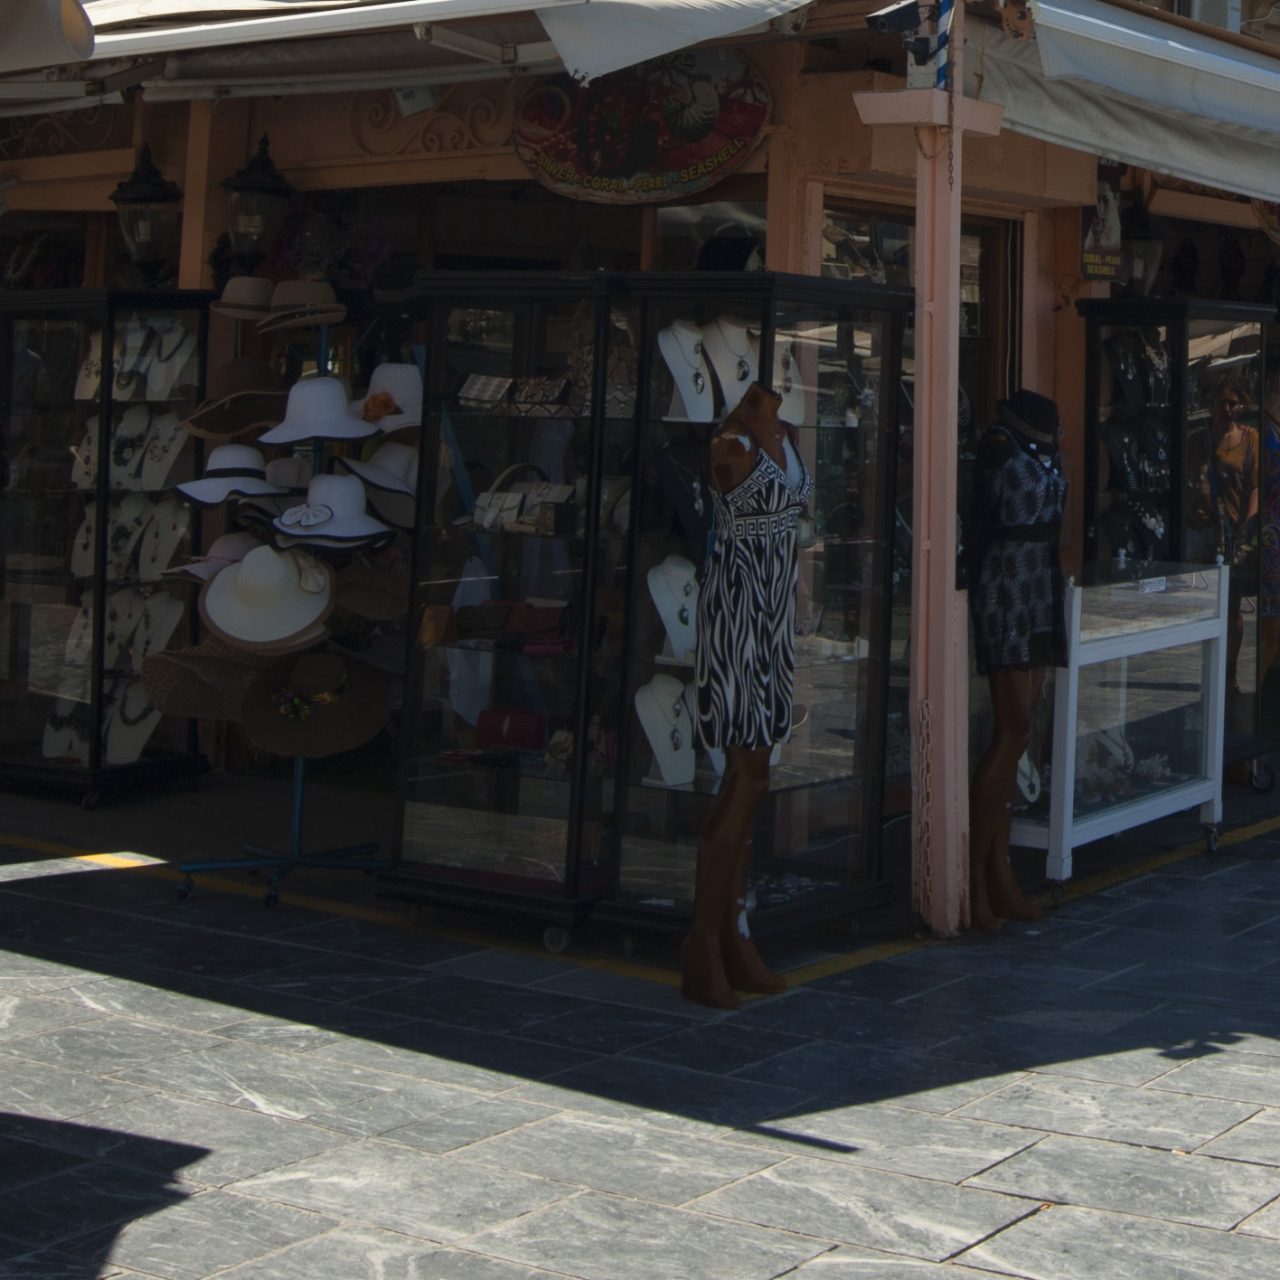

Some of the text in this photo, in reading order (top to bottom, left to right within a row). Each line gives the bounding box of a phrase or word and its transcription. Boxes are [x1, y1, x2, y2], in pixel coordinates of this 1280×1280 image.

[535, 137, 745, 193] SILVER CORAL PEARL SEASHELL
